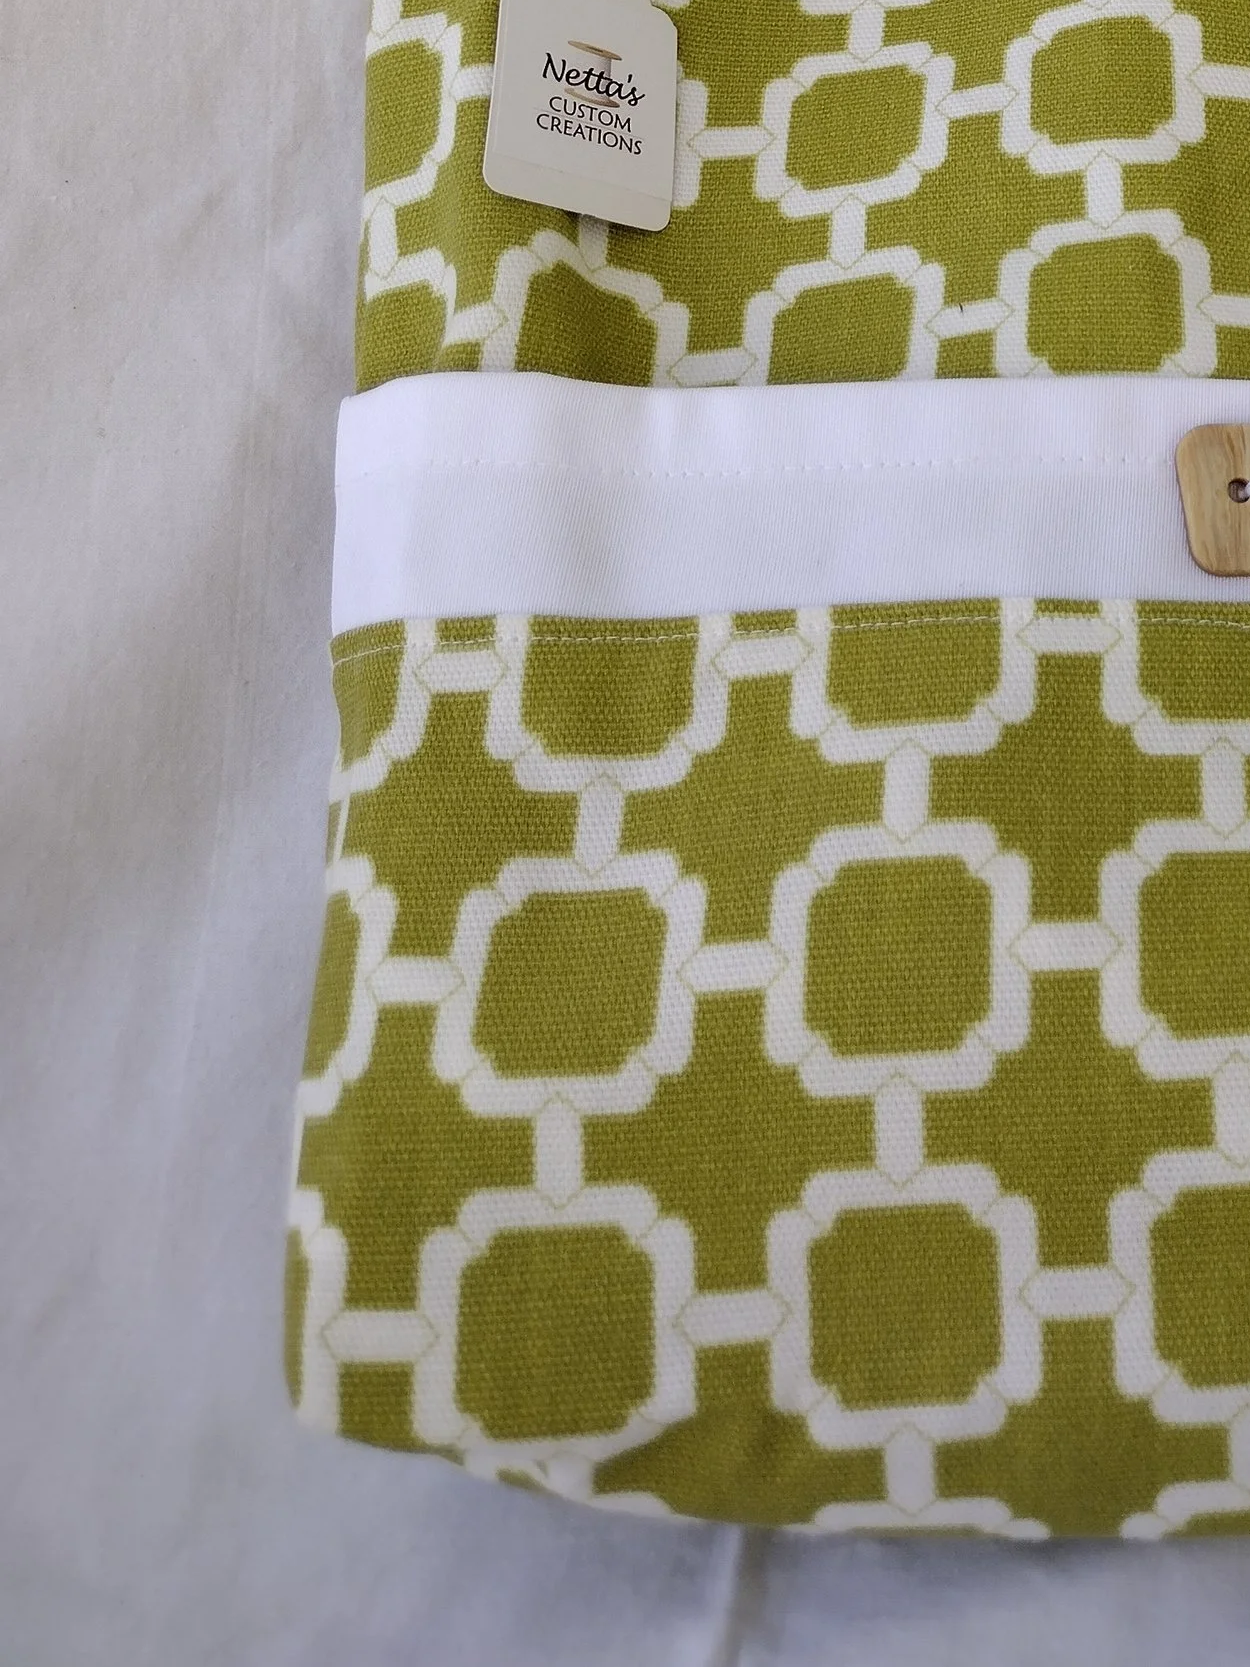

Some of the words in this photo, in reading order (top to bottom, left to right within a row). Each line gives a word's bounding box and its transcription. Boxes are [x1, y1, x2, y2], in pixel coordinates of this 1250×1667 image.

[542, 52, 646, 107] Netta's
[536, 113, 643, 155] CREATIONS
[549, 96, 632, 133] CUSTOM
